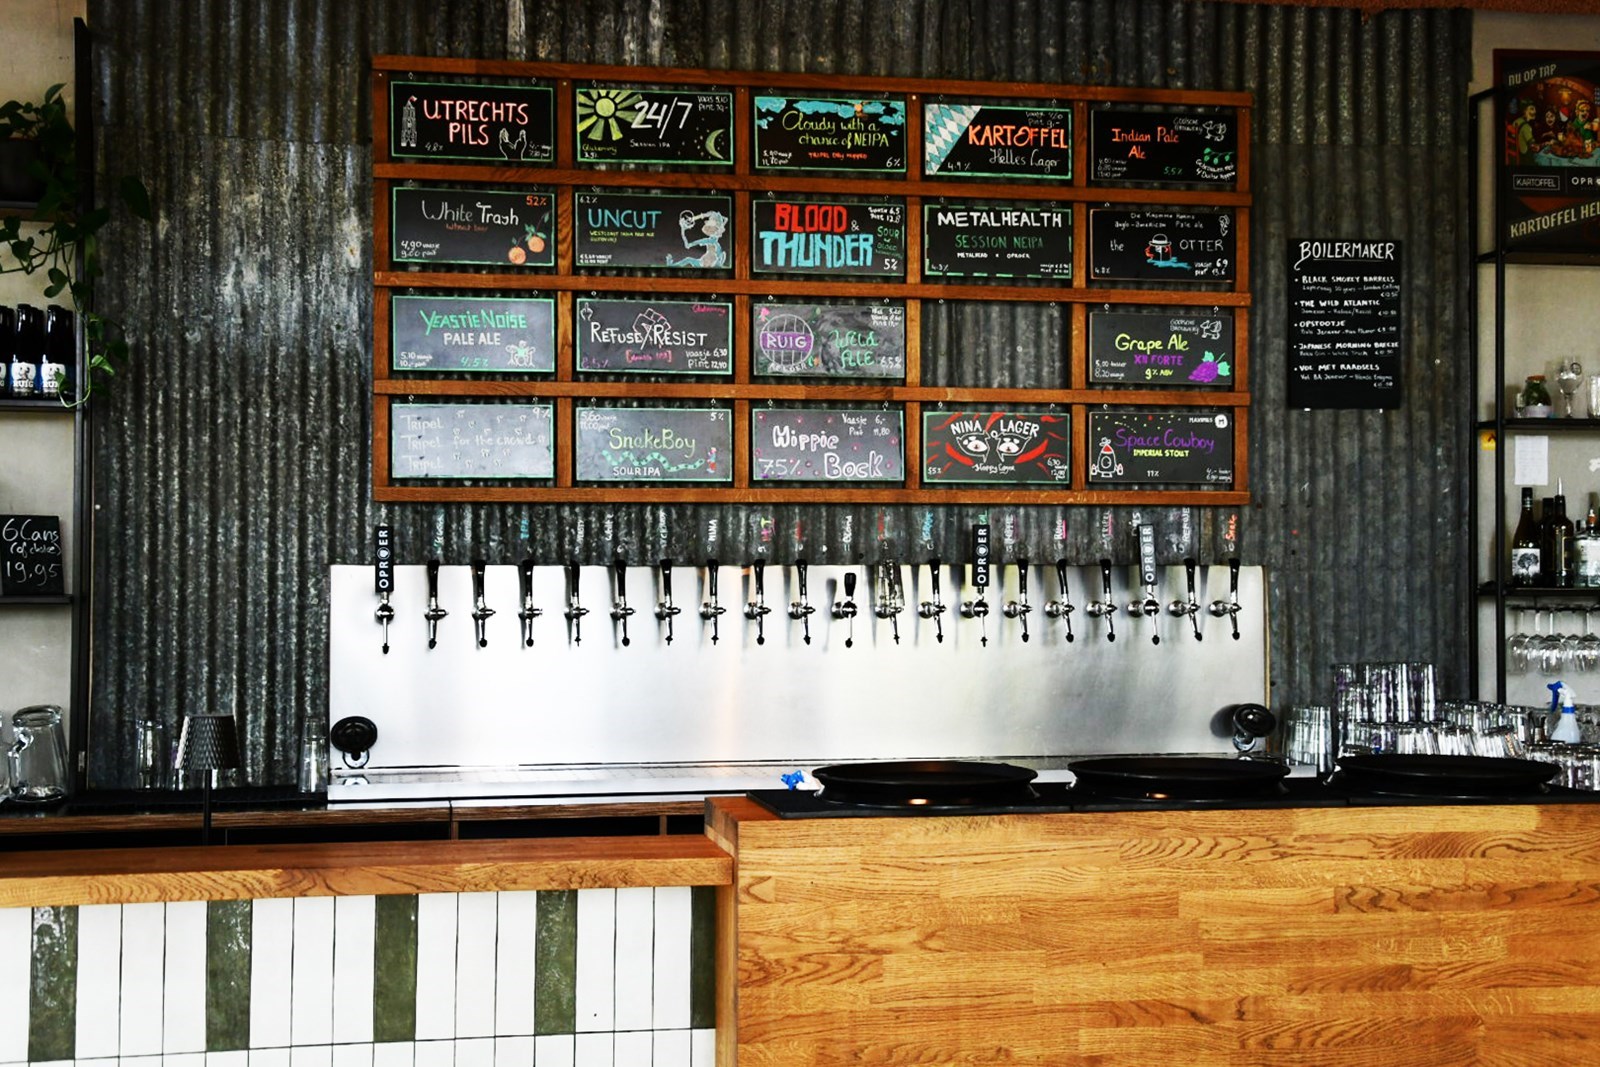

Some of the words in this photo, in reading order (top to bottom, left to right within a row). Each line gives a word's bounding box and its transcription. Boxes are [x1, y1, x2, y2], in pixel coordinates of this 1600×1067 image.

[1524, 68, 1537, 82] OP
[1539, 64, 1557, 78] TAP
[424, 99, 528, 126] UTRECHTS
[631, 96, 694, 139] 24/7
[782, 110, 836, 135] Cloudy
[840, 118, 864, 132] with
[868, 122, 880, 132] a
[449, 122, 489, 146] PILS
[798, 132, 838, 146] chance
[841, 132, 852, 150] of
[854, 132, 890, 148] NEIPA
[968, 124, 1068, 149] KARTOFFEL
[1112, 128, 1152, 142] Indian
[1156, 126, 1180, 143] Pale
[989, 148, 1027, 166] Helles
[1128, 145, 1146, 160] Ale
[1516, 177, 1557, 188] KARTOFFEL
[422, 200, 473, 222] White
[476, 202, 520, 226] Trash
[588, 208, 662, 230] UNCUT
[775, 204, 848, 232] BLOOD
[851, 220, 860, 232] &
[937, 212, 1062, 228] METALHEALTH
[1510, 208, 1577, 238] KARTOFFEL
[876, 226, 900, 240] SOUR
[954, 234, 1008, 249] SESSION
[1012, 236, 1044, 250] NEIPA
[759, 231, 874, 268] THUNDER
[1110, 239, 1124, 252] the
[1180, 239, 1224, 252] OTTER
[883, 258, 898, 270] 5%
[1294, 241, 1394, 271] BOILERMAKER
[1302, 275, 1328, 284] BLACK
[443, 332, 475, 346] PALE
[478, 332, 502, 346] ALE
[766, 333, 808, 348] RUIG
[1115, 332, 1164, 355] Grape
[1167, 334, 1190, 352] Ale
[1150, 355, 1184, 366] FORTE
[842, 413, 867, 429] Vaasje
[950, 420, 983, 436] NINA
[1000, 419, 1040, 438] LAGER
[849, 426, 864, 436] Pint
[453, 436, 470, 449] for
[476, 434, 494, 446] the
[1116, 428, 1160, 452] Space
[1164, 428, 1216, 454] Cowboy
[1133, 449, 1164, 457] IMPERIAL
[1164, 450, 1190, 458] STOUT
[613, 466, 642, 476] SOUR
[643, 467, 662, 476] IPA
[824, 450, 884, 480] Bock
[2, 518, 18, 542] 6
[20, 518, 60, 544] Cans
